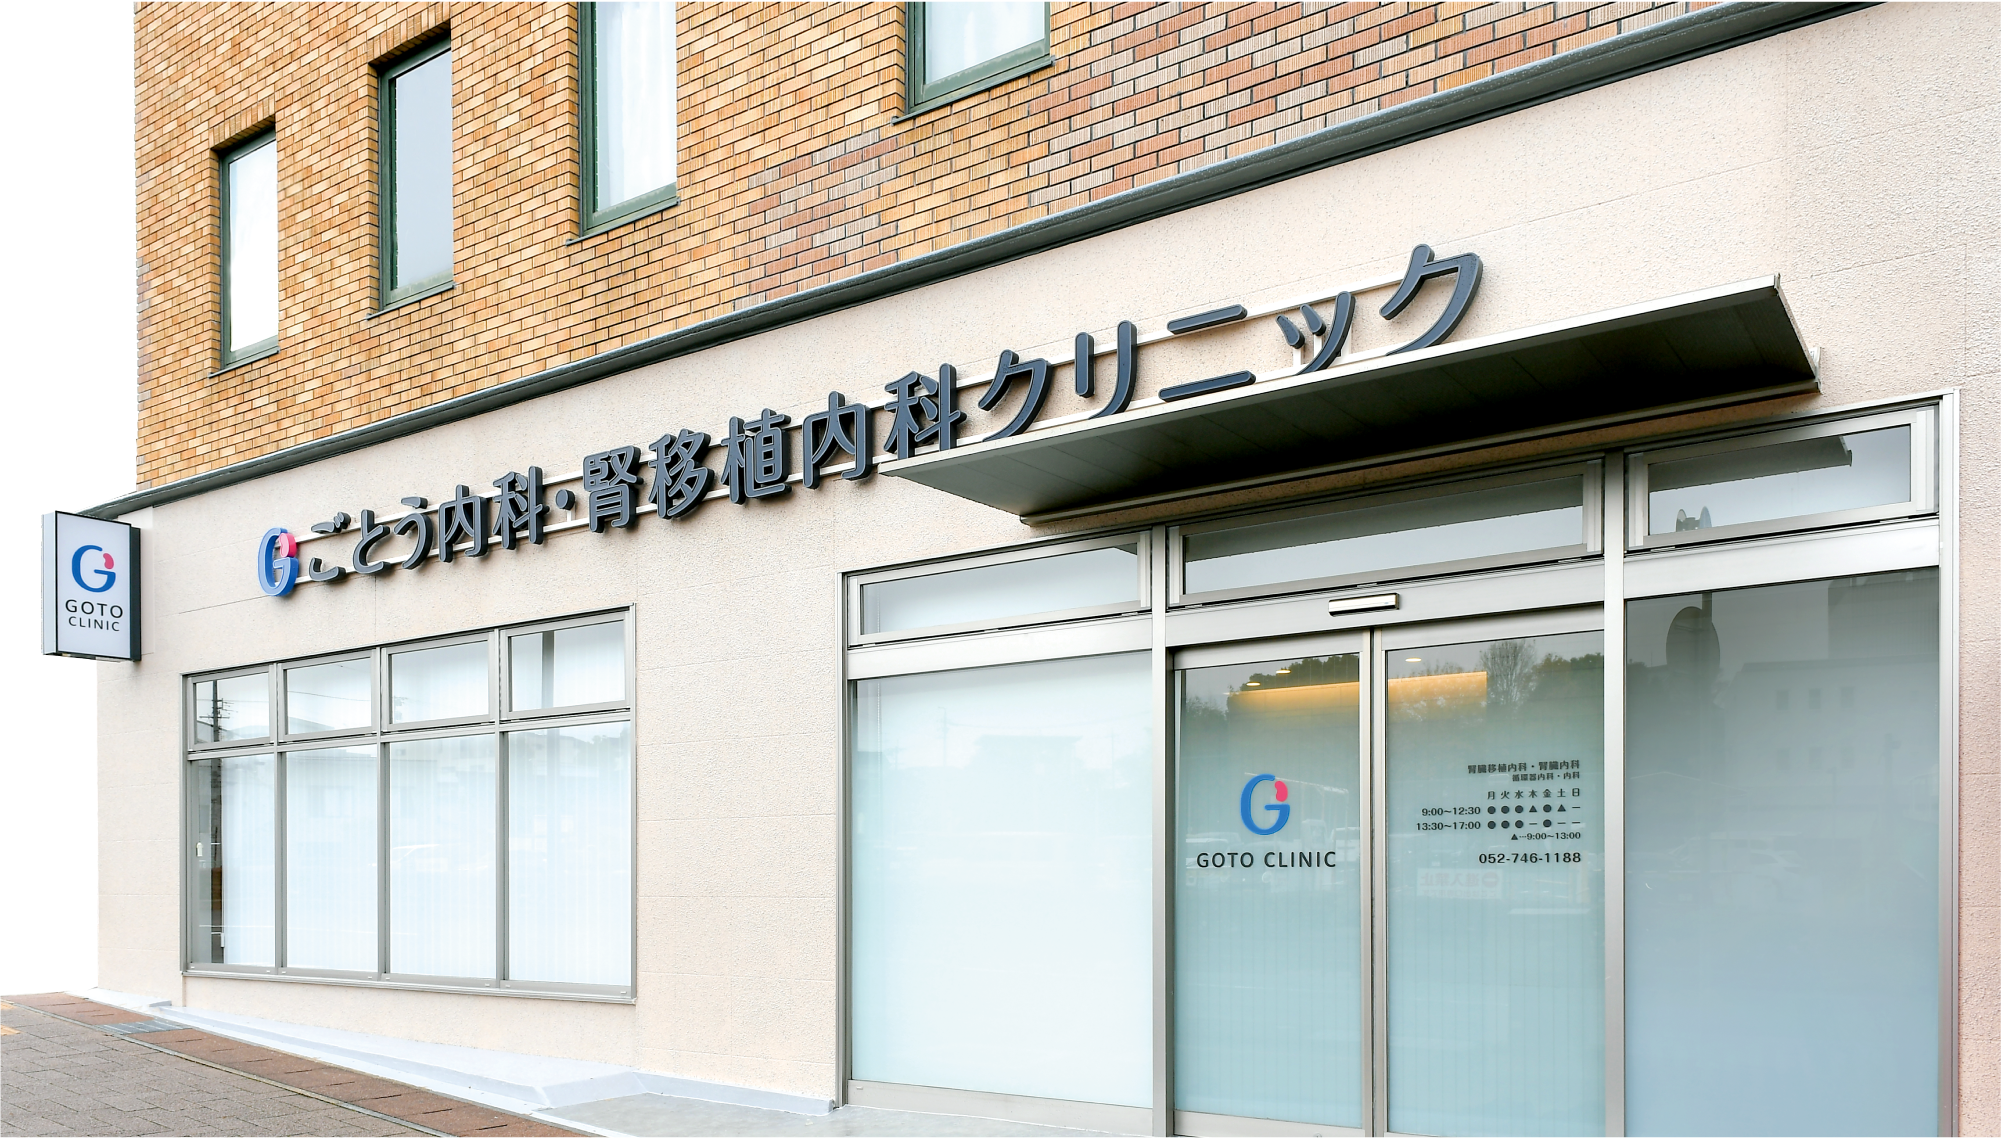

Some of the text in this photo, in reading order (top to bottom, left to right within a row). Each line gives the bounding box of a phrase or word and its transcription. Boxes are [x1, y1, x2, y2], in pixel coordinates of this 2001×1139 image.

[65, 599, 124, 619] GOTO
[68, 616, 120, 632] CLINIC
[1196, 851, 1336, 868] GOTO CLINIC
[1478, 852, 1581, 864] 052-746-1188
